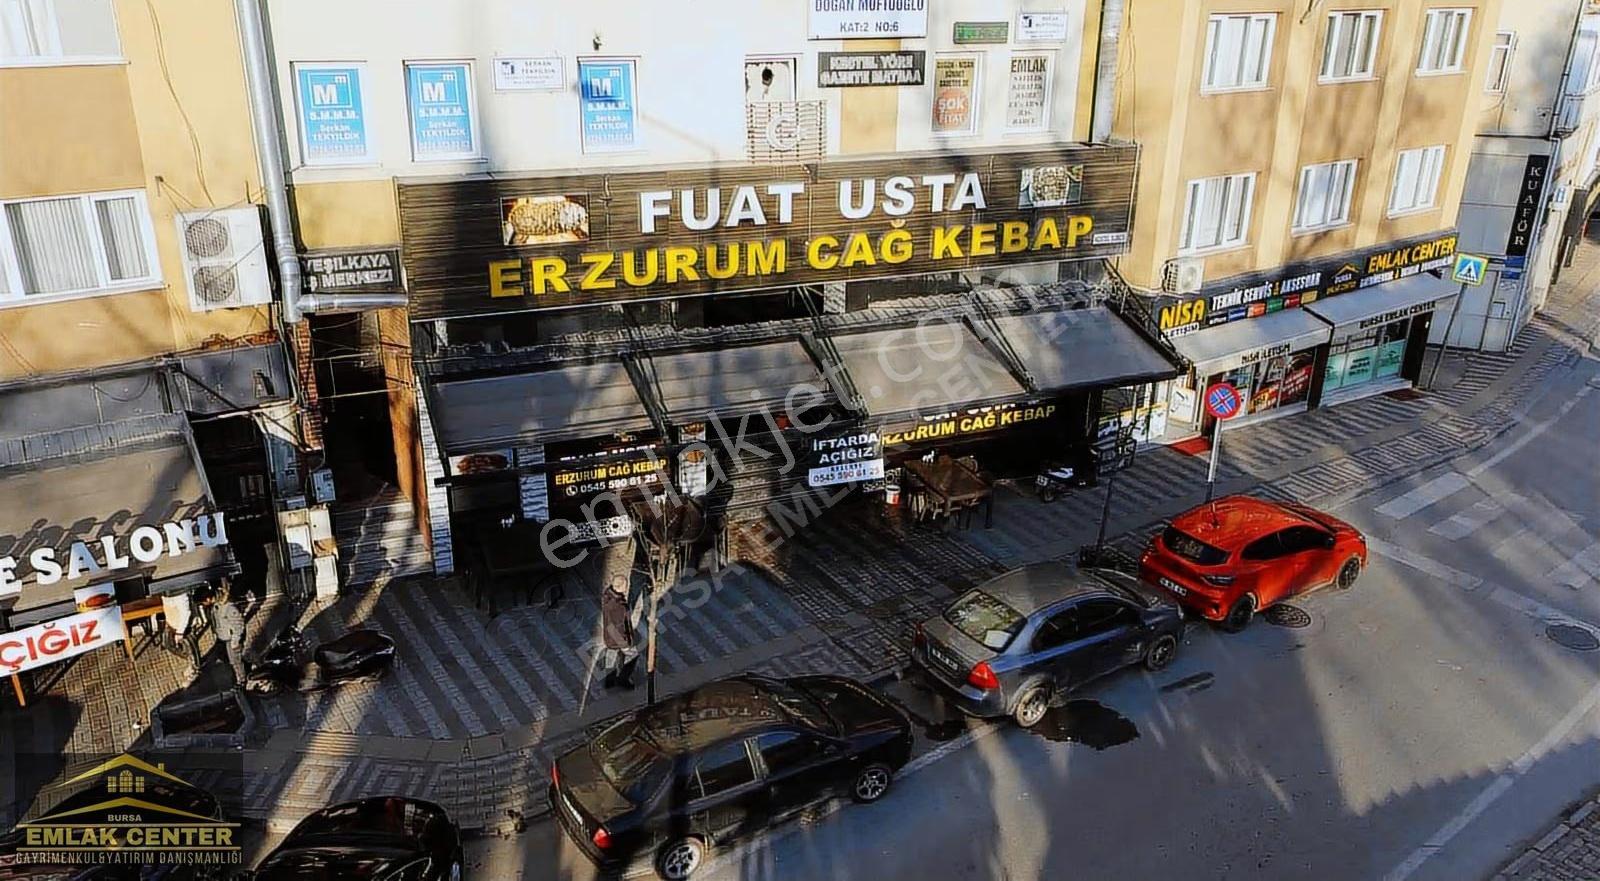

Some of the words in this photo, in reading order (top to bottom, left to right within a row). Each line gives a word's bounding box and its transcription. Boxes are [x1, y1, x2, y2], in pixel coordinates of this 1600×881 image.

[1010, 58, 1047, 73] EMLAK
[640, 181, 805, 234] FUAT
[839, 172, 987, 219] USTA
[489, 239, 788, 298] ERZURUM
[806, 219, 914, 270] CAĞ
[932, 215, 1094, 260] KEBAP
[1368, 248, 1410, 273] EMLAK
[1412, 237, 1456, 263] CENTER
[1160, 300, 1204, 330] NİSA
[1001, 405, 1056, 426] KEBAP
[555, 468, 607, 486] ERZURUM
[608, 463, 631, 477] CAĞ
[632, 458, 667, 474] KEBAP
[580, 481, 606, 493] 0545
[30, 511, 229, 585] SALONU
